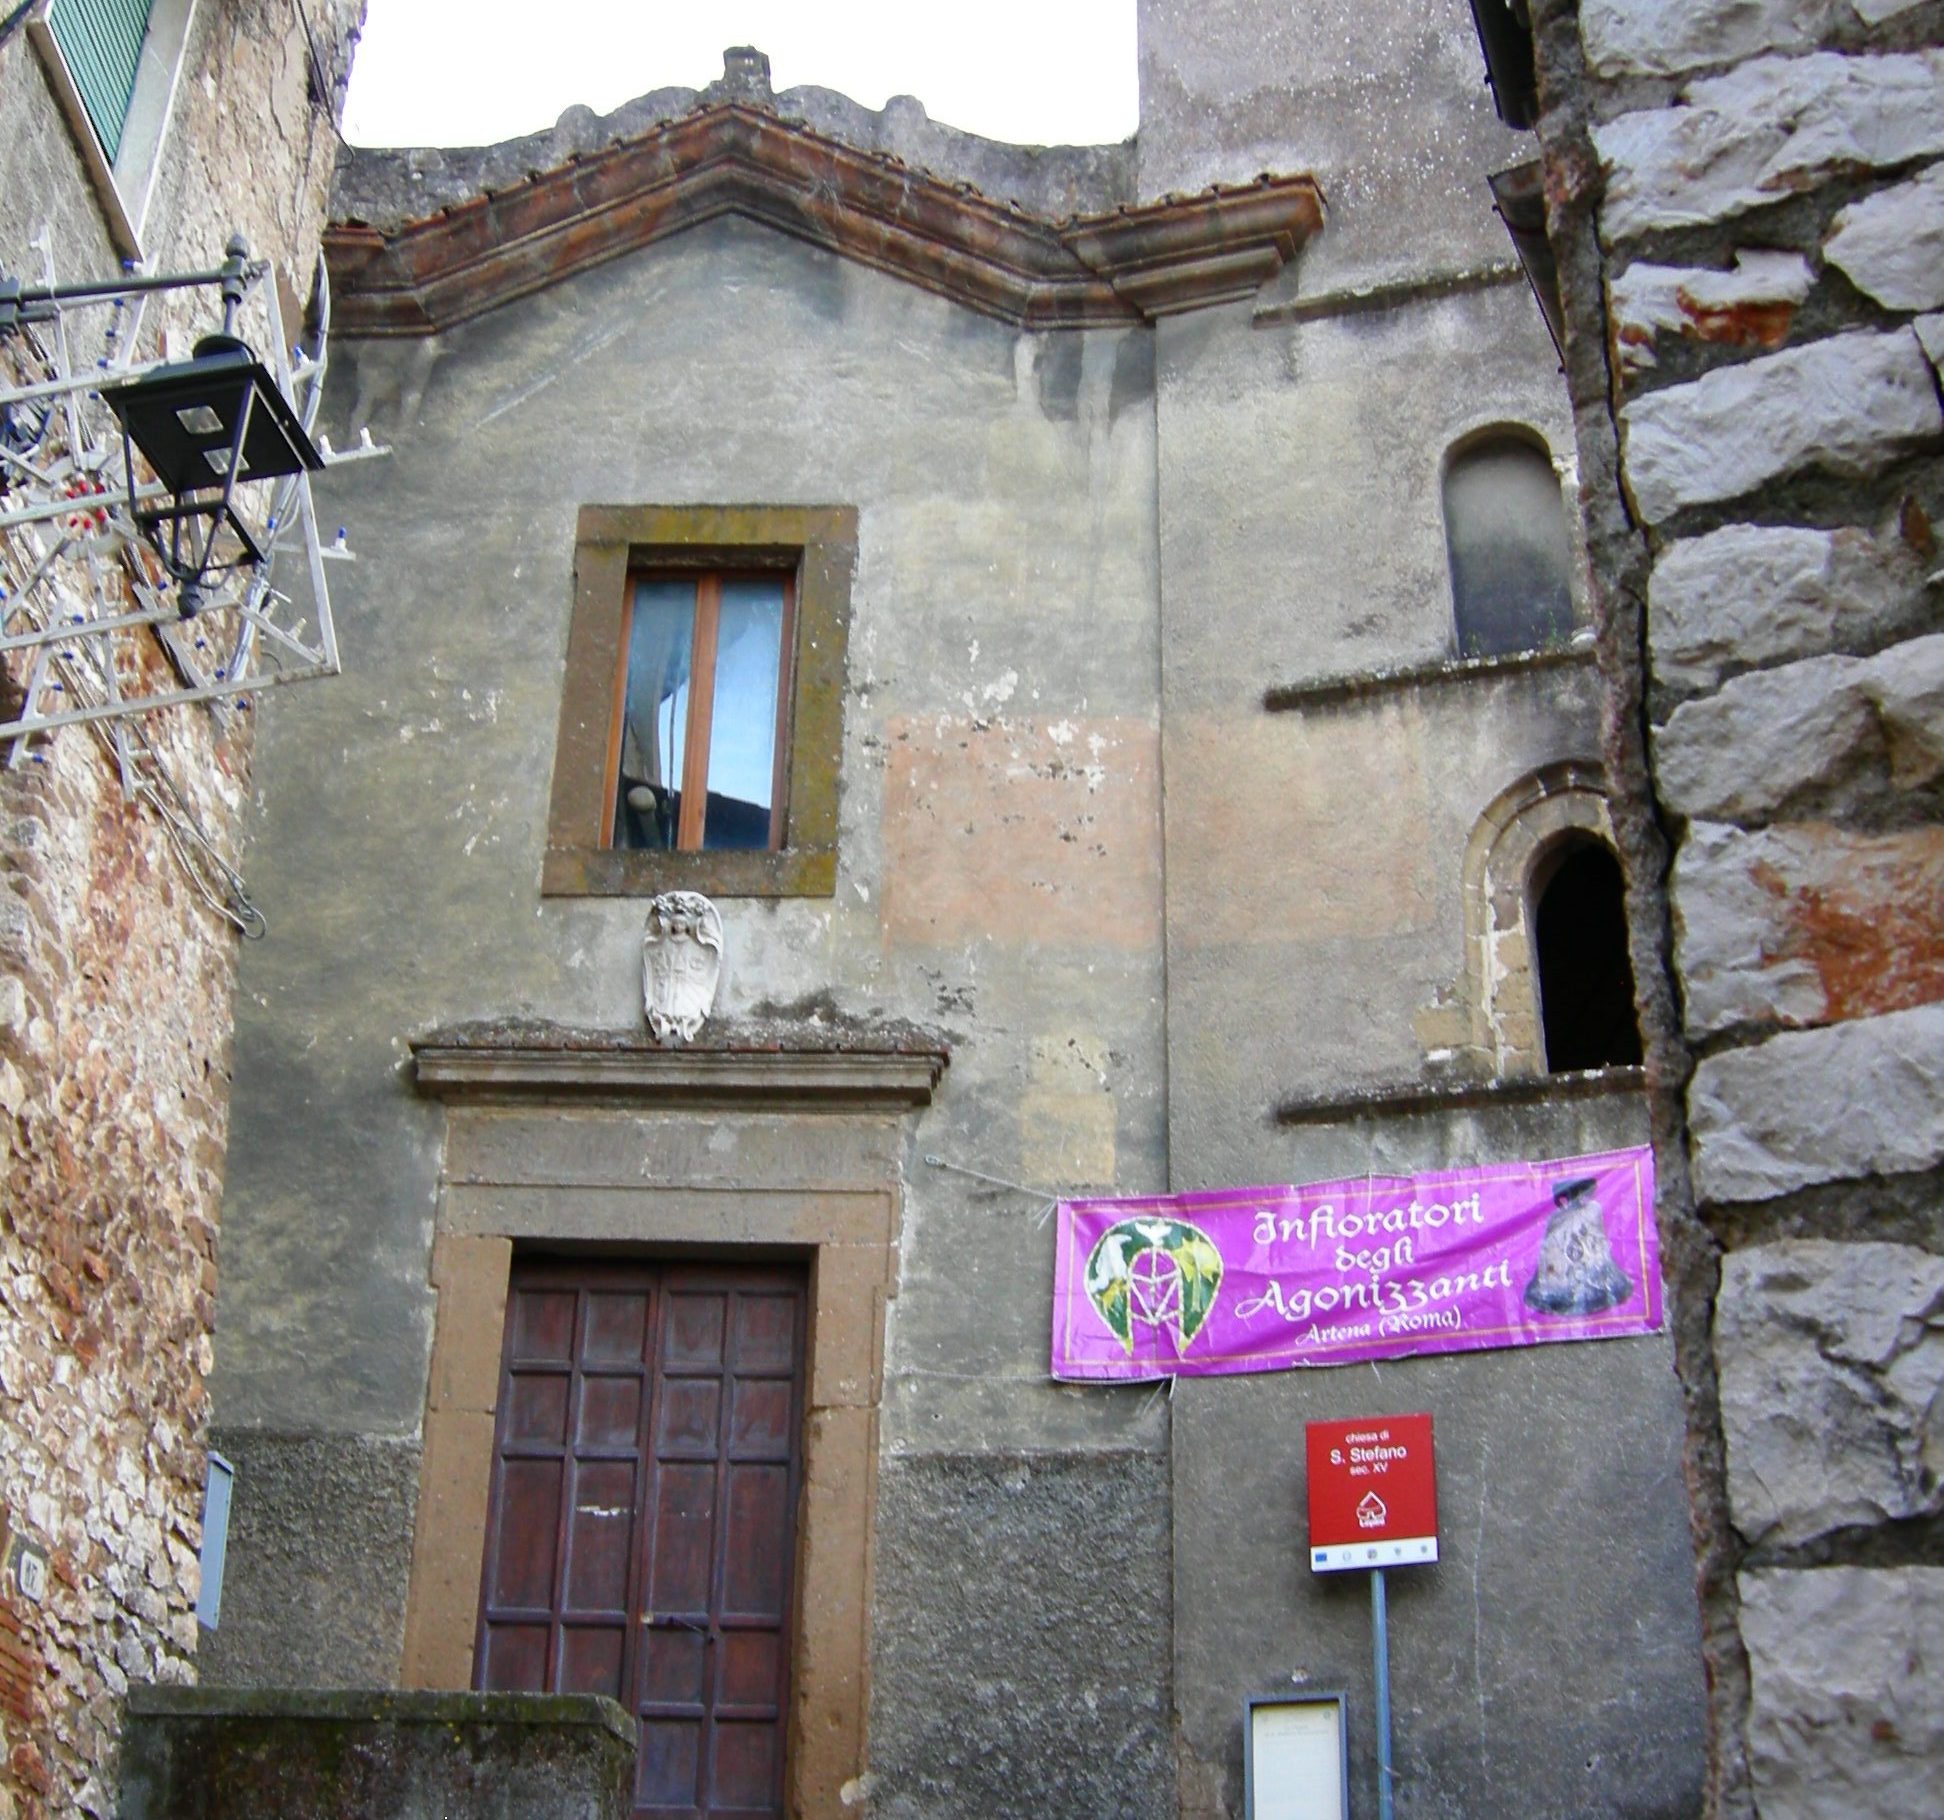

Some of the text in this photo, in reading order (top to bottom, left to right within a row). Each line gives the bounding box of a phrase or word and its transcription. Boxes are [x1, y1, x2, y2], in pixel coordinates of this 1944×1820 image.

[1253, 1193, 1484, 1250] Infioratori
[1335, 1236, 1414, 1273] degli
[1234, 1260, 1512, 1321] Agonizzanti
[1295, 1305, 1462, 1346] Artena (Roma)
[1330, 1445, 1407, 1465] S. Stefano
[1373, 1461, 1388, 1473] XV
